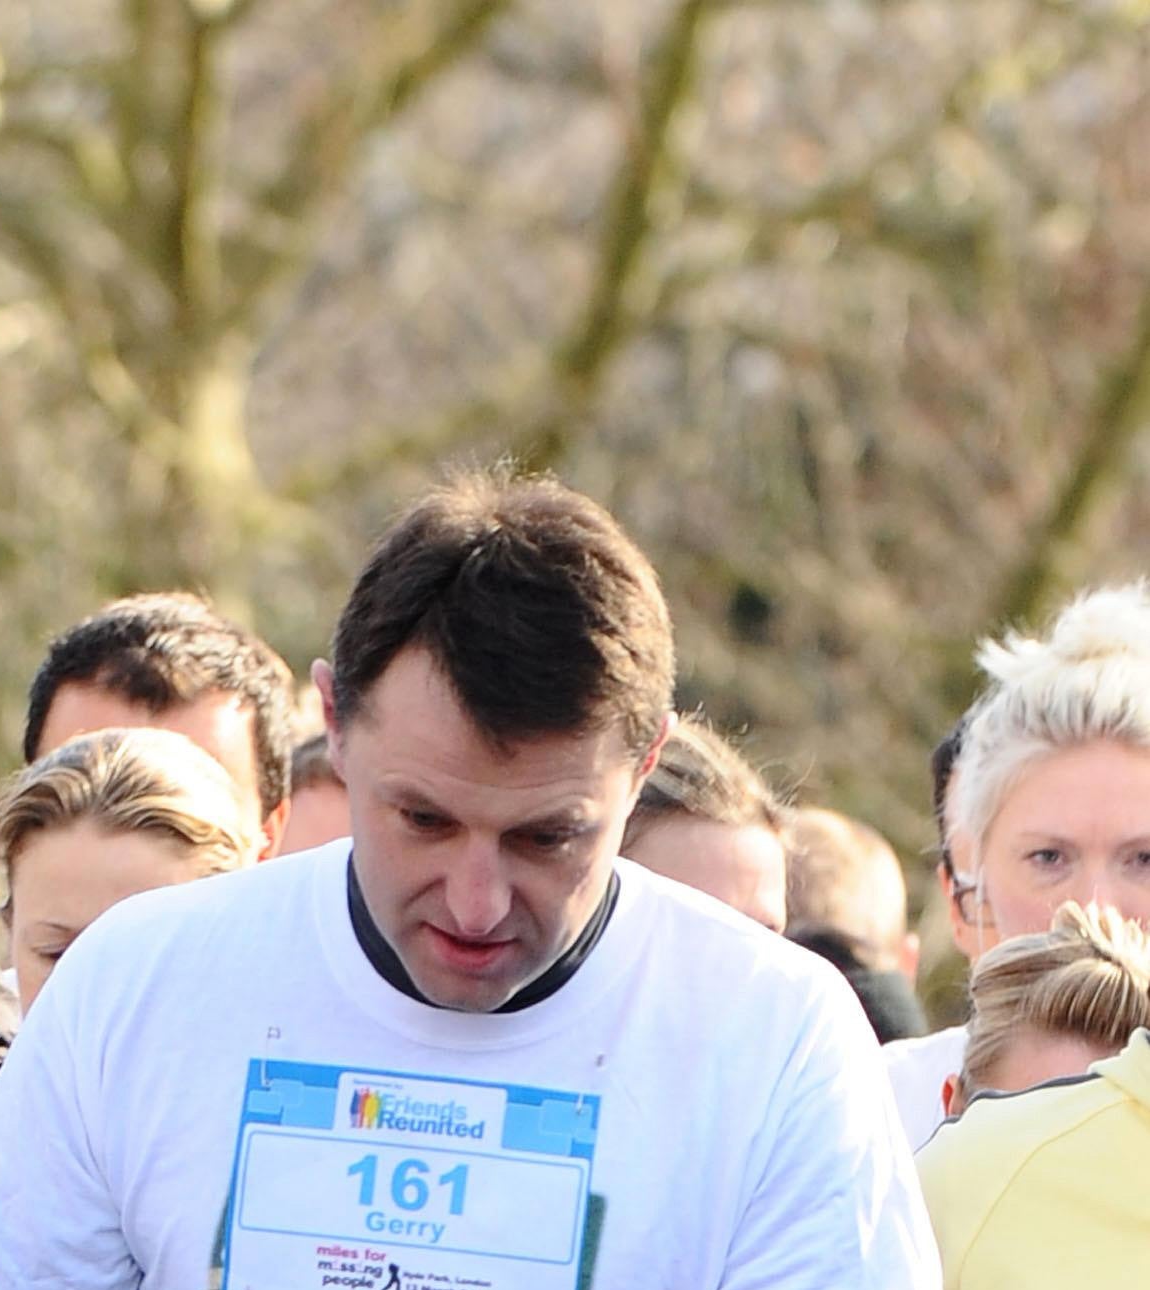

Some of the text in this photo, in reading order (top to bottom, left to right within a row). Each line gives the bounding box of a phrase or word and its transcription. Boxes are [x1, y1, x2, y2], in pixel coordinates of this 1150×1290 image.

[381, 1092, 467, 1120] Friends
[377, 1110, 486, 1139] Reunited
[346, 1154, 470, 1216] 161
[365, 1211, 447, 1244] Gerry
[317, 1245, 388, 1262] miles for
[322, 1273, 376, 1290] people
